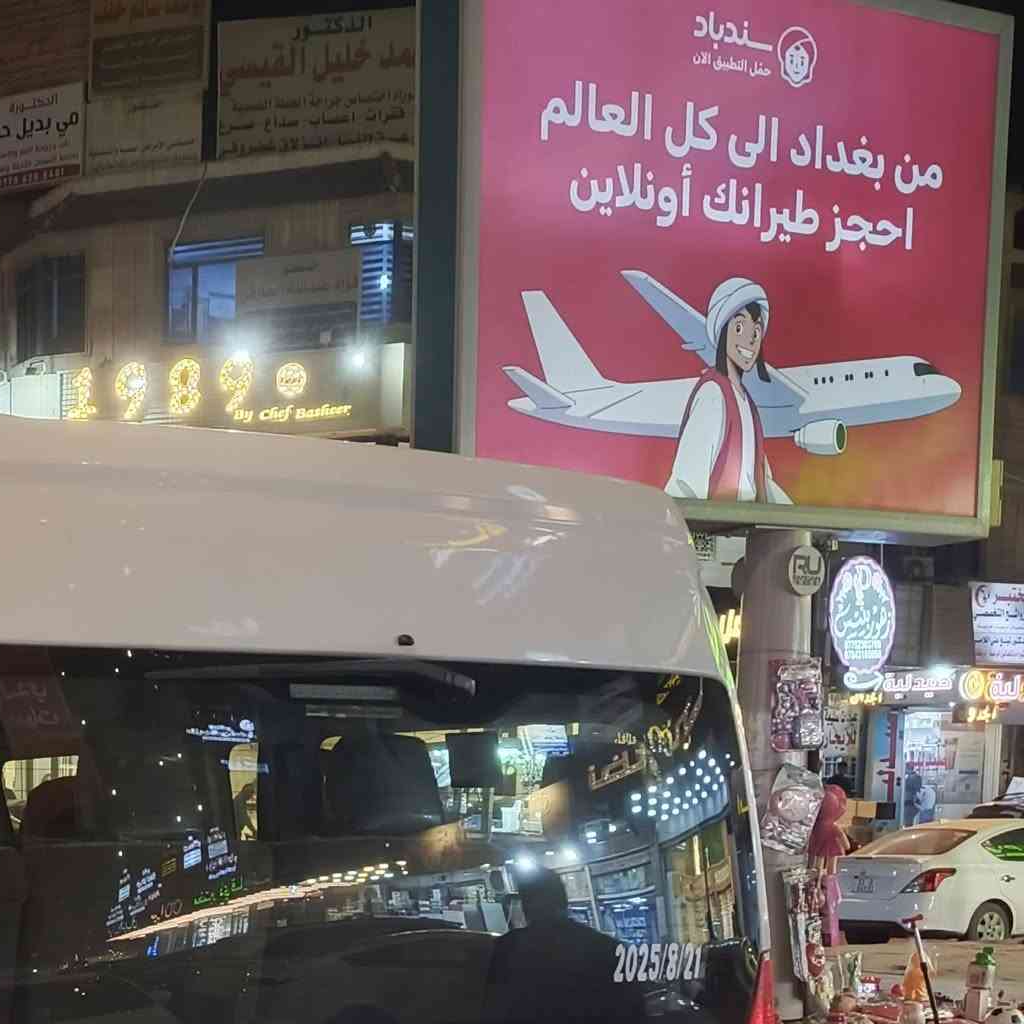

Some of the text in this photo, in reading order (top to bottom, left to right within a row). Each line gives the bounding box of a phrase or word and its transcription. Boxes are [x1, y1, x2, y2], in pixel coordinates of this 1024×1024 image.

[291, 15, 372, 41] الدكتور
[712, 55, 748, 72] التطبيق
[56, 112, 80, 137] مي
[539, 80, 653, 140] العالم
[16, 117, 51, 140] بديل
[664, 102, 720, 158] كل
[789, 125, 886, 190] بغداد
[894, 153, 944, 193] من
[569, 162, 914, 252] احجز طيرانك أونلاين
[233, 409, 253, 423] By
[259, 404, 294, 422] Chef
[882, 672, 954, 700] صيدلية
[613, 942, 703, 983] 2025/8/21
